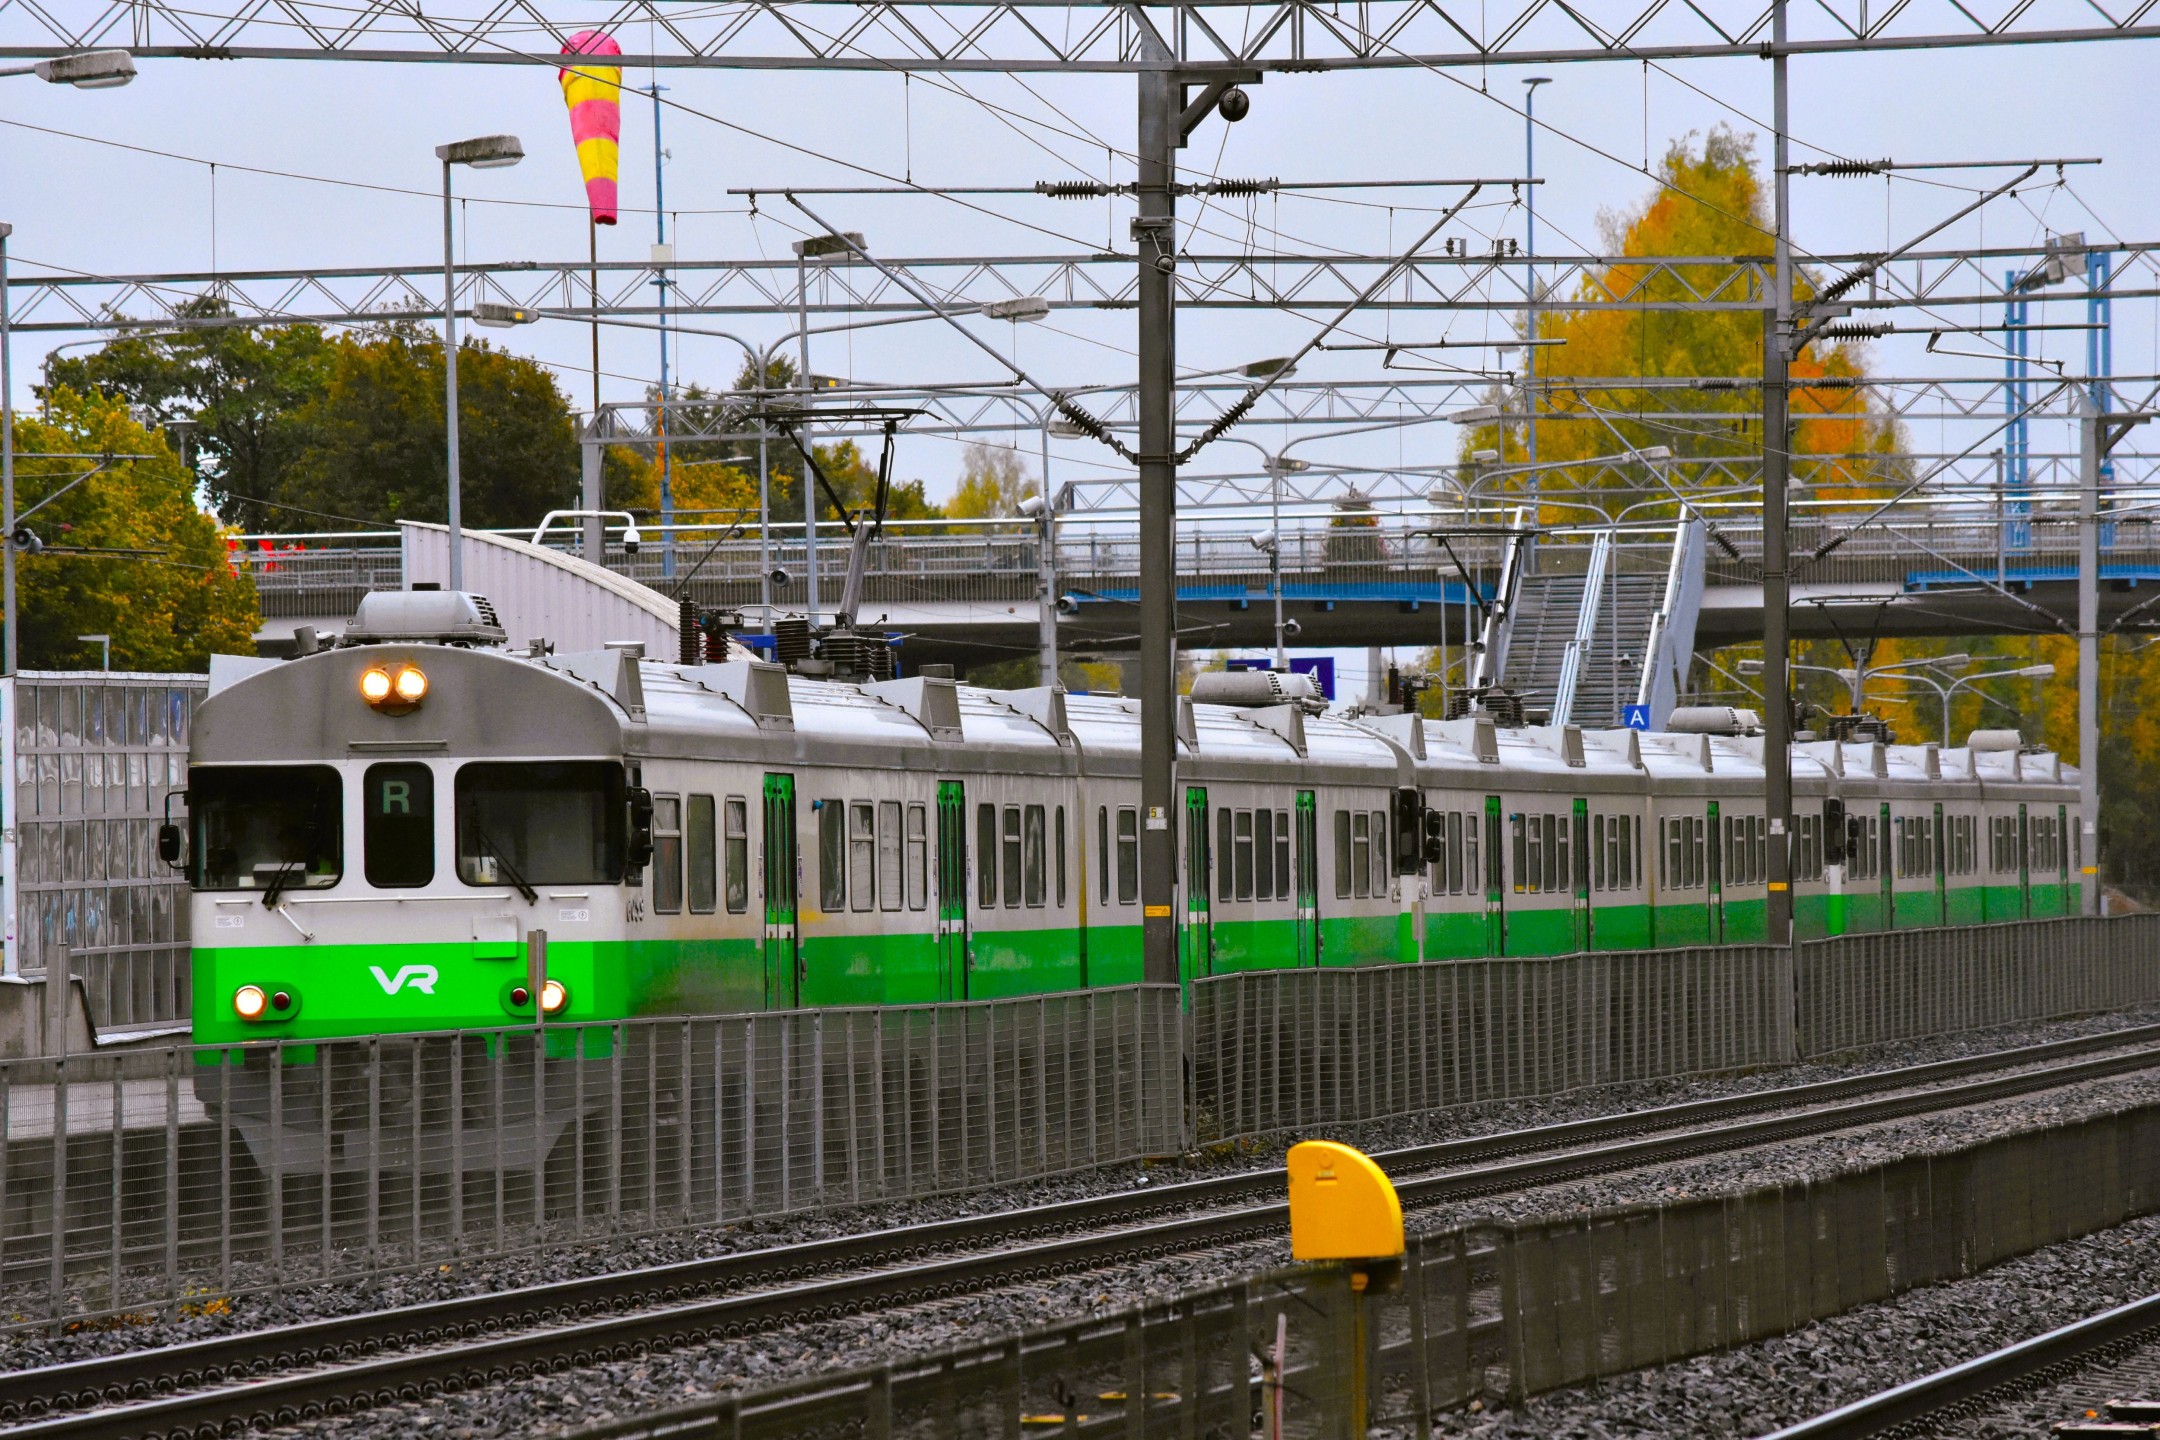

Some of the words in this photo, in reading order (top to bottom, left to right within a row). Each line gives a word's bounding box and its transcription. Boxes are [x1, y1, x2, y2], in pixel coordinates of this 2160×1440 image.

[1630, 709, 1645, 725] A
[383, 781, 410, 813] R
[368, 964, 439, 995] VR
